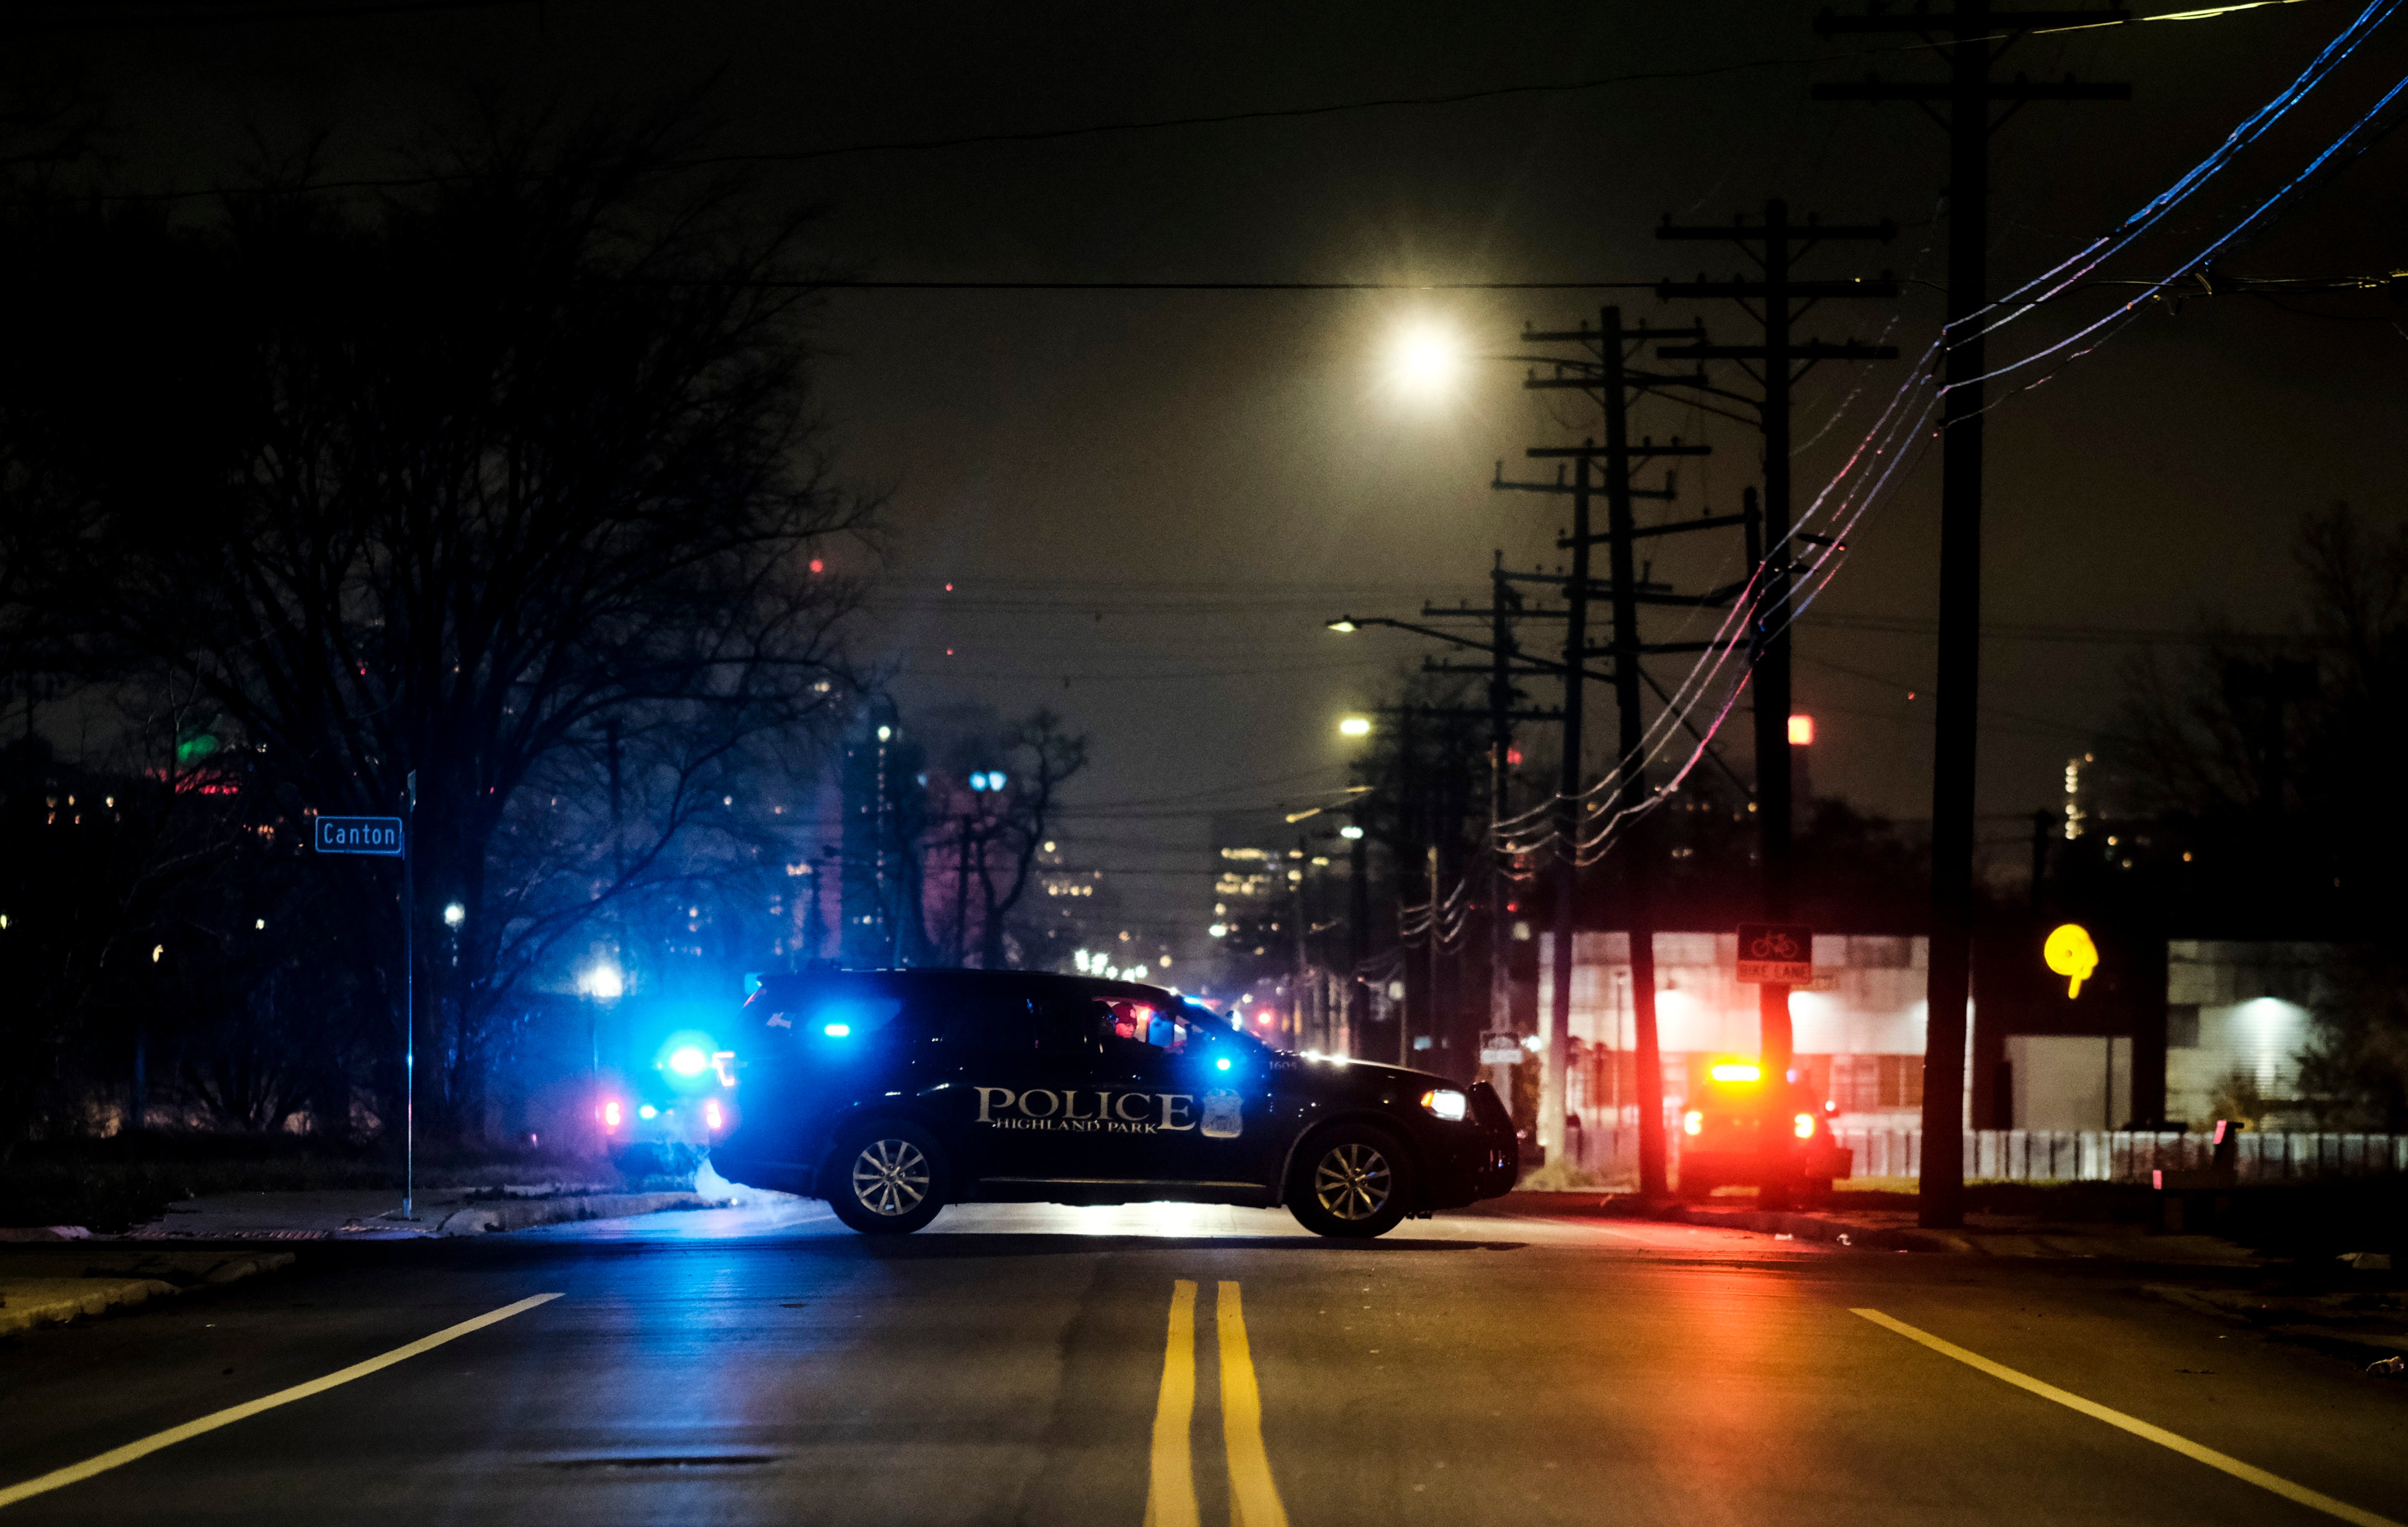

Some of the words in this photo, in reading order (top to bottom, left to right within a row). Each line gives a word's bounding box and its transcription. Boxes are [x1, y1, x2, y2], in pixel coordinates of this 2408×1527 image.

[324, 823, 394, 845] Canton
[1739, 965, 1769, 978] BIKE
[1774, 965, 1809, 979] LANE
[973, 1086, 1196, 1131] POLICE
[996, 1118, 1100, 1132] HIGHLAND
[1108, 1122, 1157, 1134] PARK
